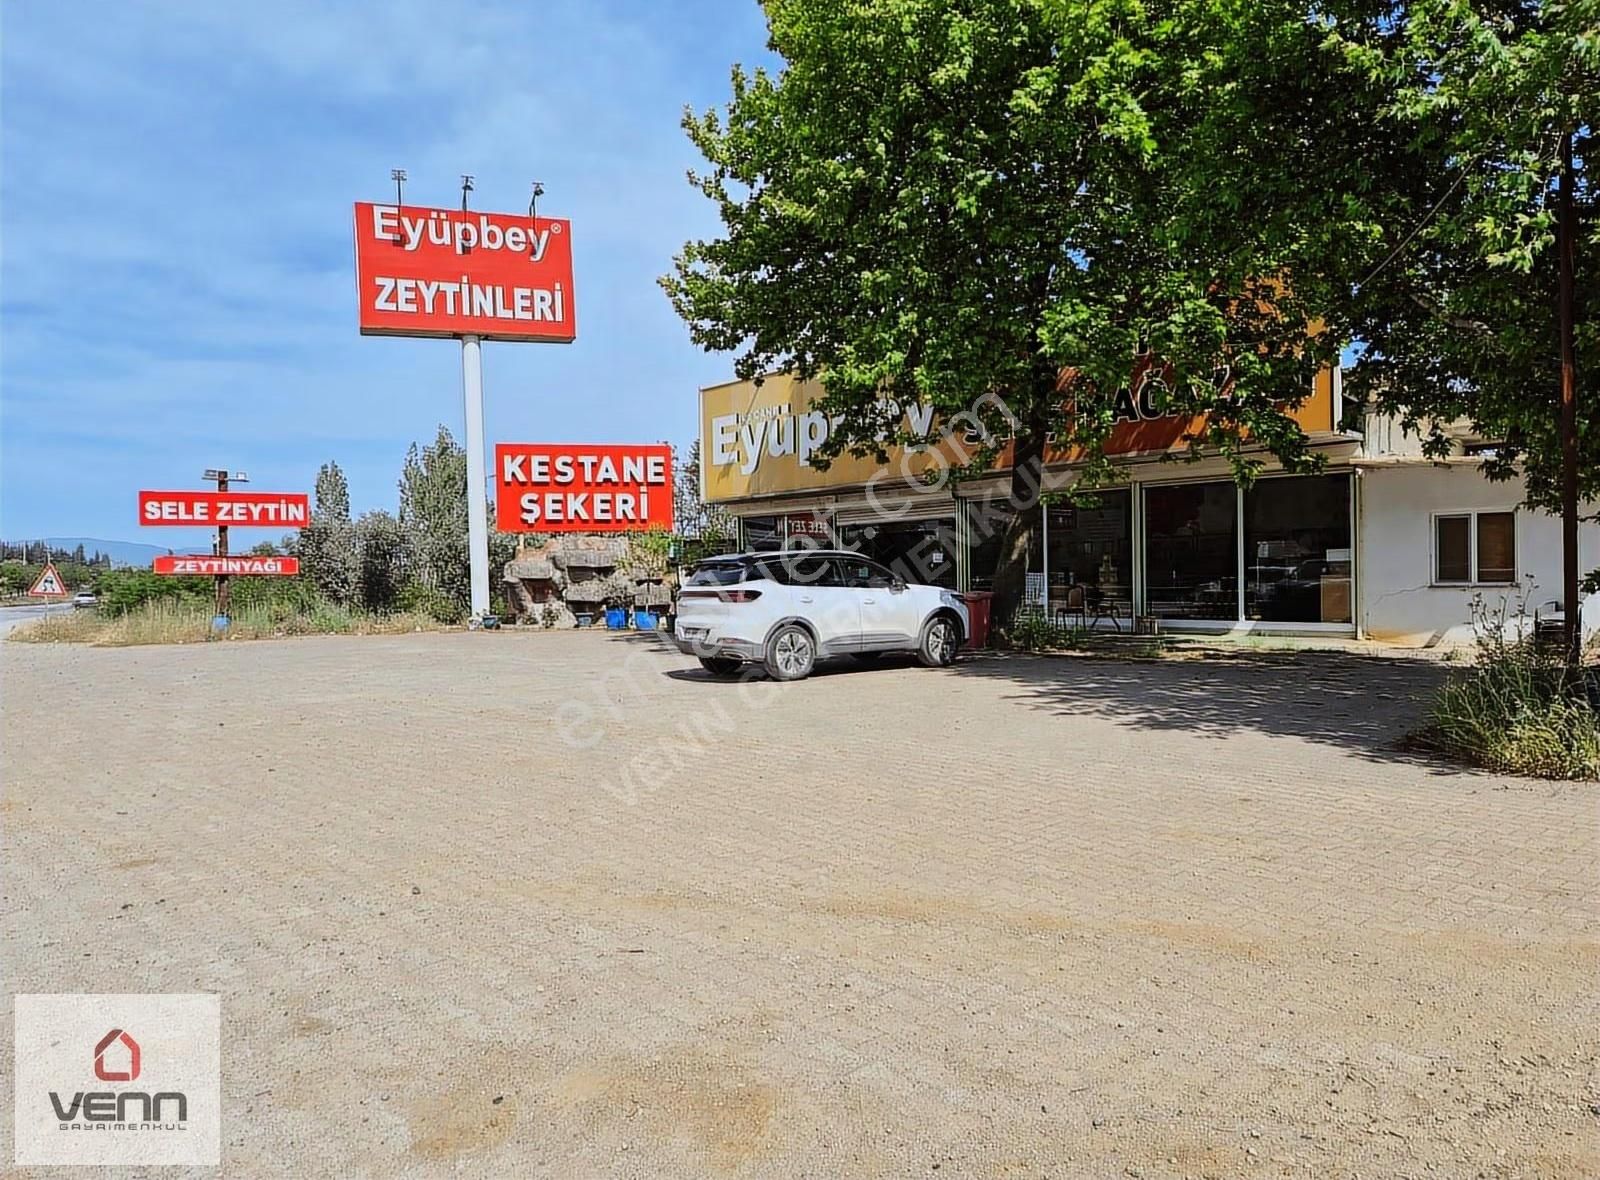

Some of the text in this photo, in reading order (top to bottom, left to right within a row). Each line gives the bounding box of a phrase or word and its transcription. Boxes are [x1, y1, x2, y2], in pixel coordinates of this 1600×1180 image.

[372, 205, 549, 262] Eyüpbey
[374, 276, 563, 322] ZEYTİNLERİ
[503, 455, 666, 483] KESTANE
[145, 500, 305, 521] SELE ZEYTİN
[520, 486, 649, 524] ŞEKERİ
[173, 557, 282, 574] ZEYTİNYAĞI
